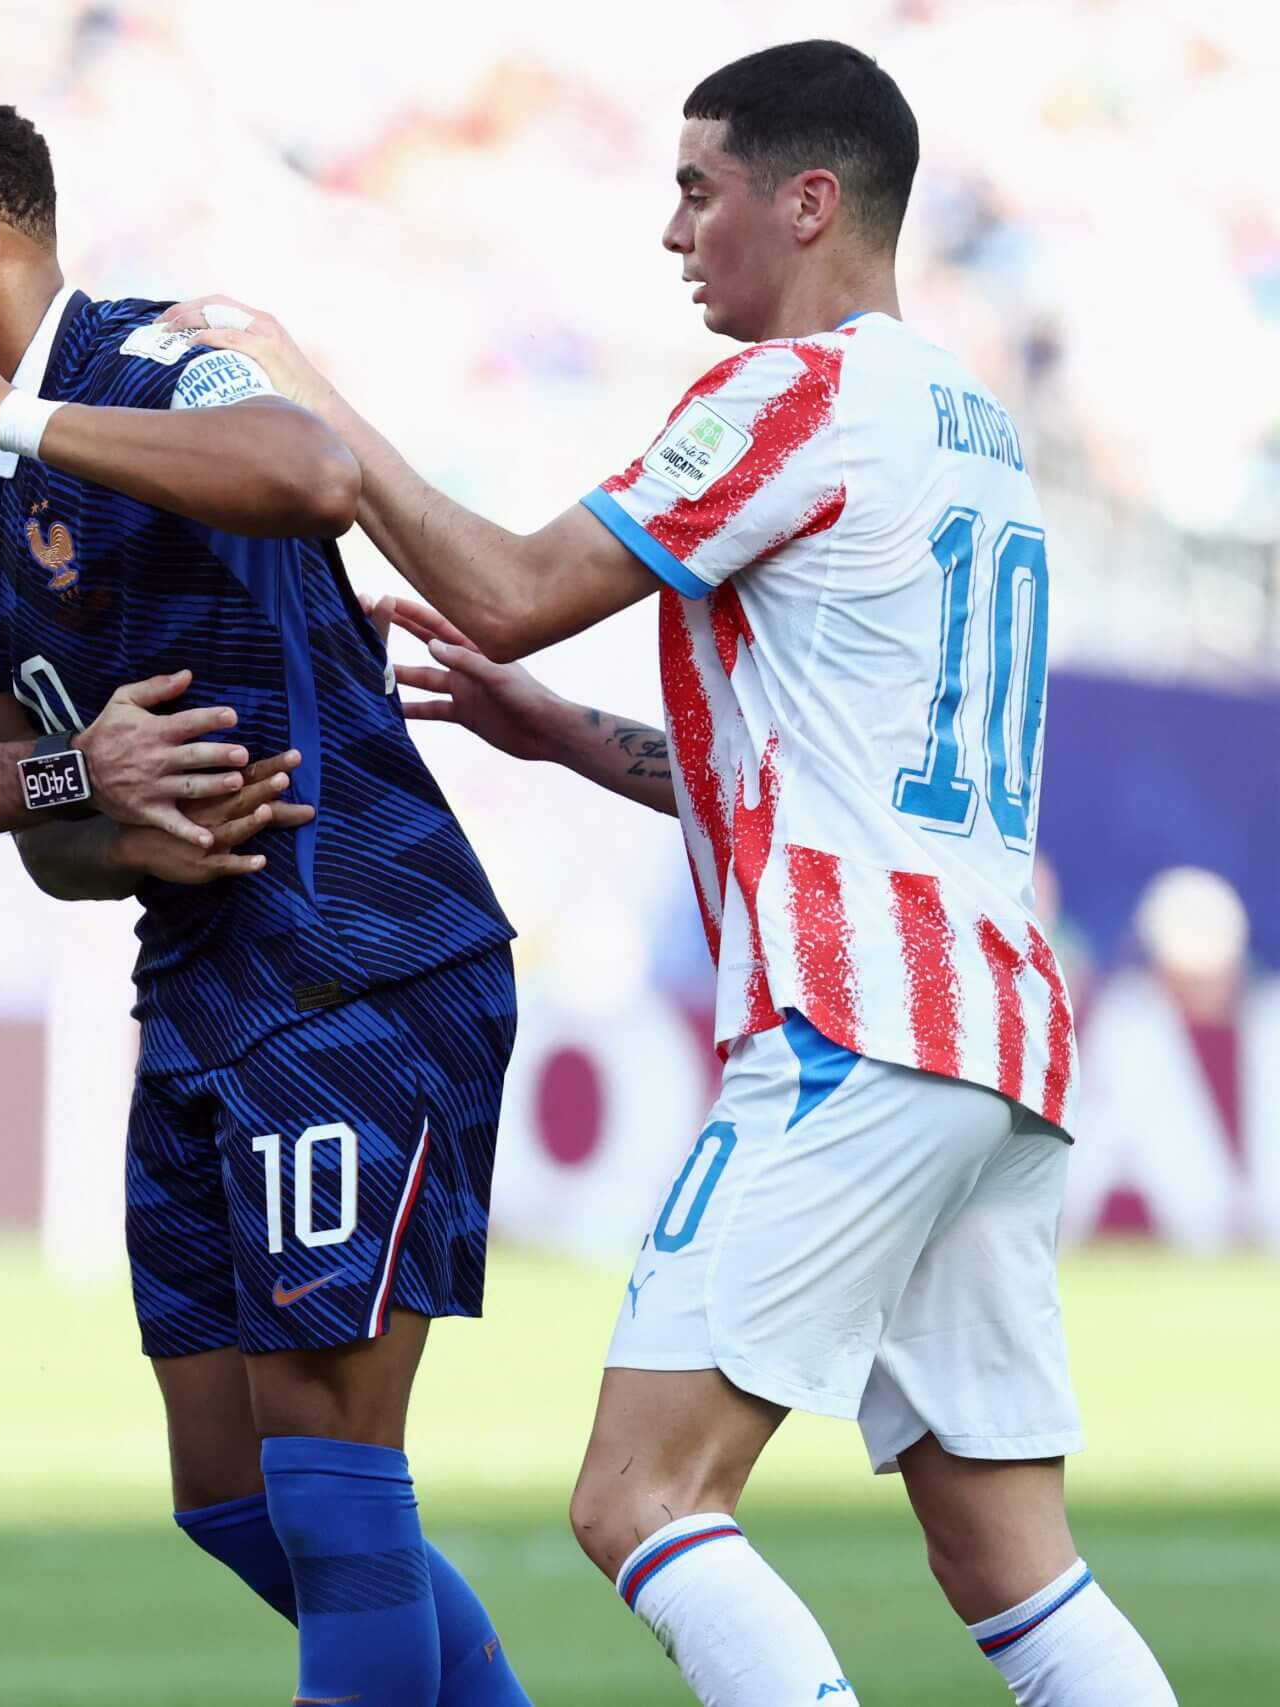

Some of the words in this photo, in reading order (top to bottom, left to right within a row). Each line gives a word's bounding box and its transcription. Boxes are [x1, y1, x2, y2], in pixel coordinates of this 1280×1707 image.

[175, 352, 242, 397] FOOTBALL
[184, 363, 252, 406] UNITES
[659, 446, 706, 481] EDUCATION
[695, 451, 712, 466] For
[892, 505, 1049, 856] 10
[26, 766, 80, 799] 34:06
[252, 1122, 358, 1254] 10
[642, 1120, 738, 1254] 0
